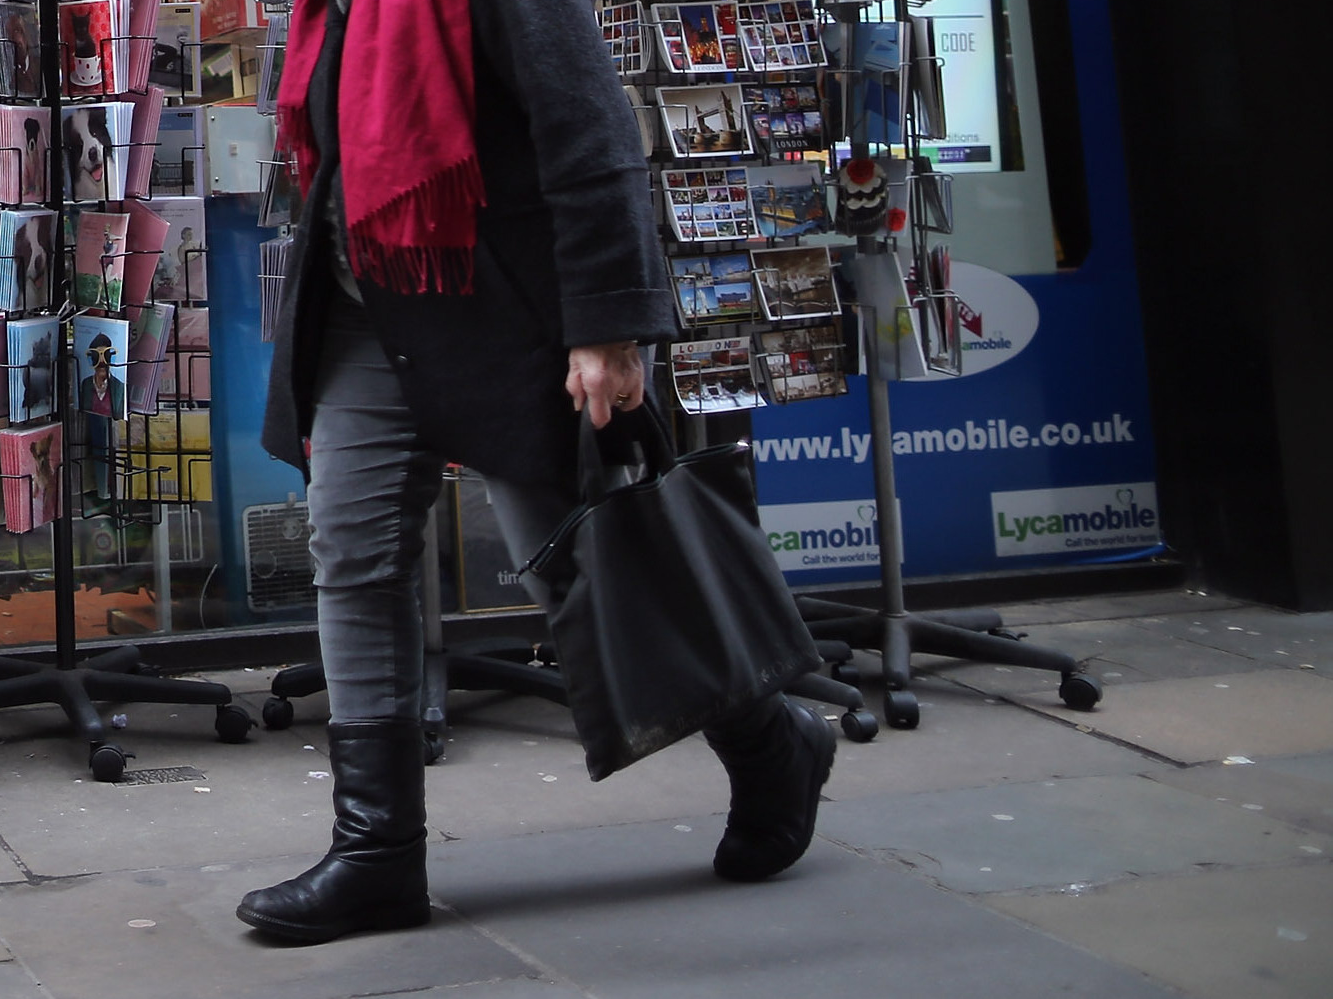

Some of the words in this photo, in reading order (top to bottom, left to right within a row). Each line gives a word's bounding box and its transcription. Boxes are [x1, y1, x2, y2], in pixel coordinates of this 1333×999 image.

[940, 31, 976, 53] CODE
[775, 140, 809, 149] LONDON
[751, 413, 1134, 464] www.lyamobile.co.uk
[997, 501, 1155, 543] Lycamobile
[1065, 537, 1082, 547] Call
[802, 555, 822, 565] Call
[839, 552, 865, 563] world
